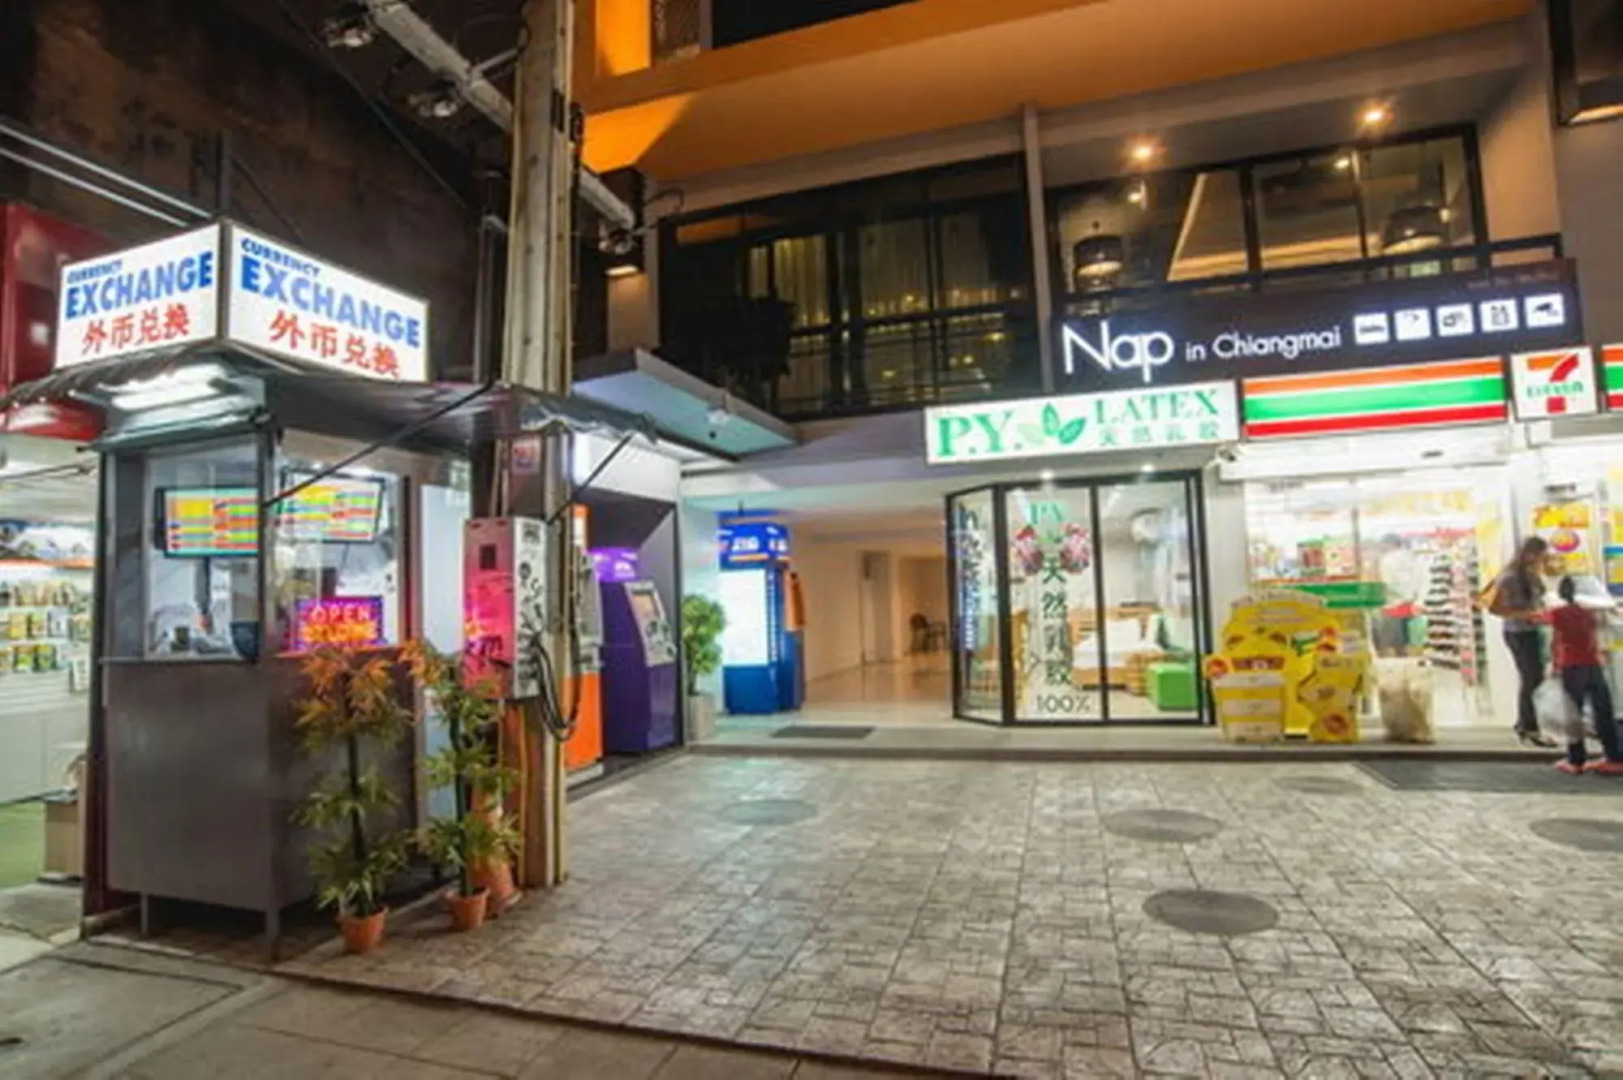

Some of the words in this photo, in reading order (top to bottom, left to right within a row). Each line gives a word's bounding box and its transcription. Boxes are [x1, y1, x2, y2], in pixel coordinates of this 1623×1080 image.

[241, 237, 321, 277] CURRENCY
[65, 251, 213, 320] EXCHANGE
[241, 254, 420, 348] EXCHANGE
[82, 303, 189, 356] 外币兑换
[269, 309, 400, 379] 外币兑换
[1062, 319, 1174, 383] Nap
[1186, 341, 1206, 362] in
[1212, 325, 1342, 360] Chiangmai
[1093, 388, 1220, 424] LATEX
[310, 604, 371, 623] OPEN
[1036, 693, 1091, 713] 100%
